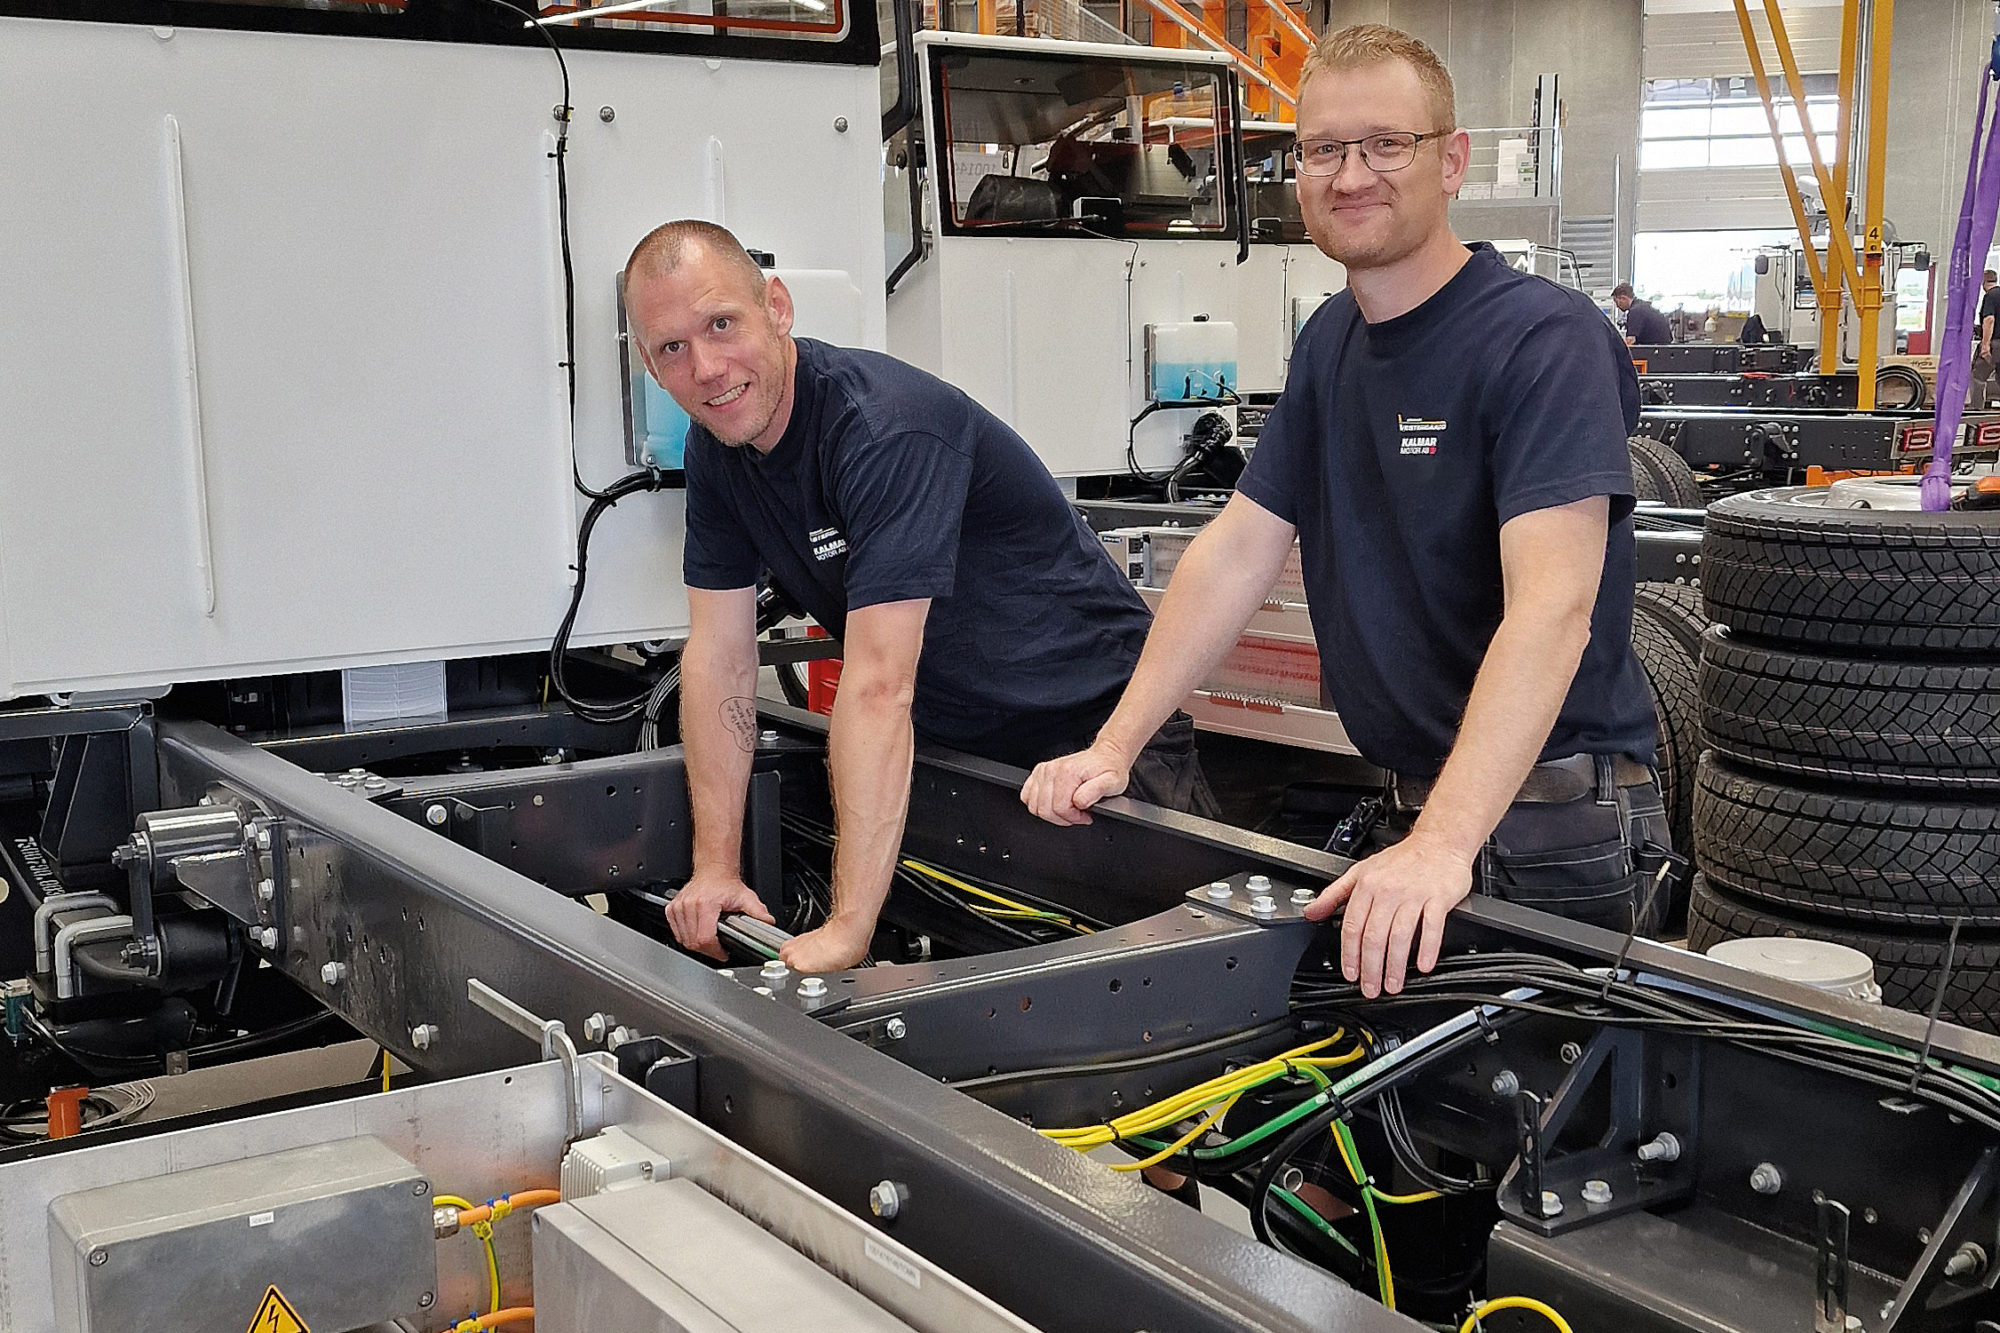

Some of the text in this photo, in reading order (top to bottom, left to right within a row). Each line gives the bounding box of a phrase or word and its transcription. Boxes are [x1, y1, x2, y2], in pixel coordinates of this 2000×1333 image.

[1868, 226, 1880, 240] 4
[1401, 437, 1437, 447] KALMAR
[1400, 447, 1422, 455] MOTOR
